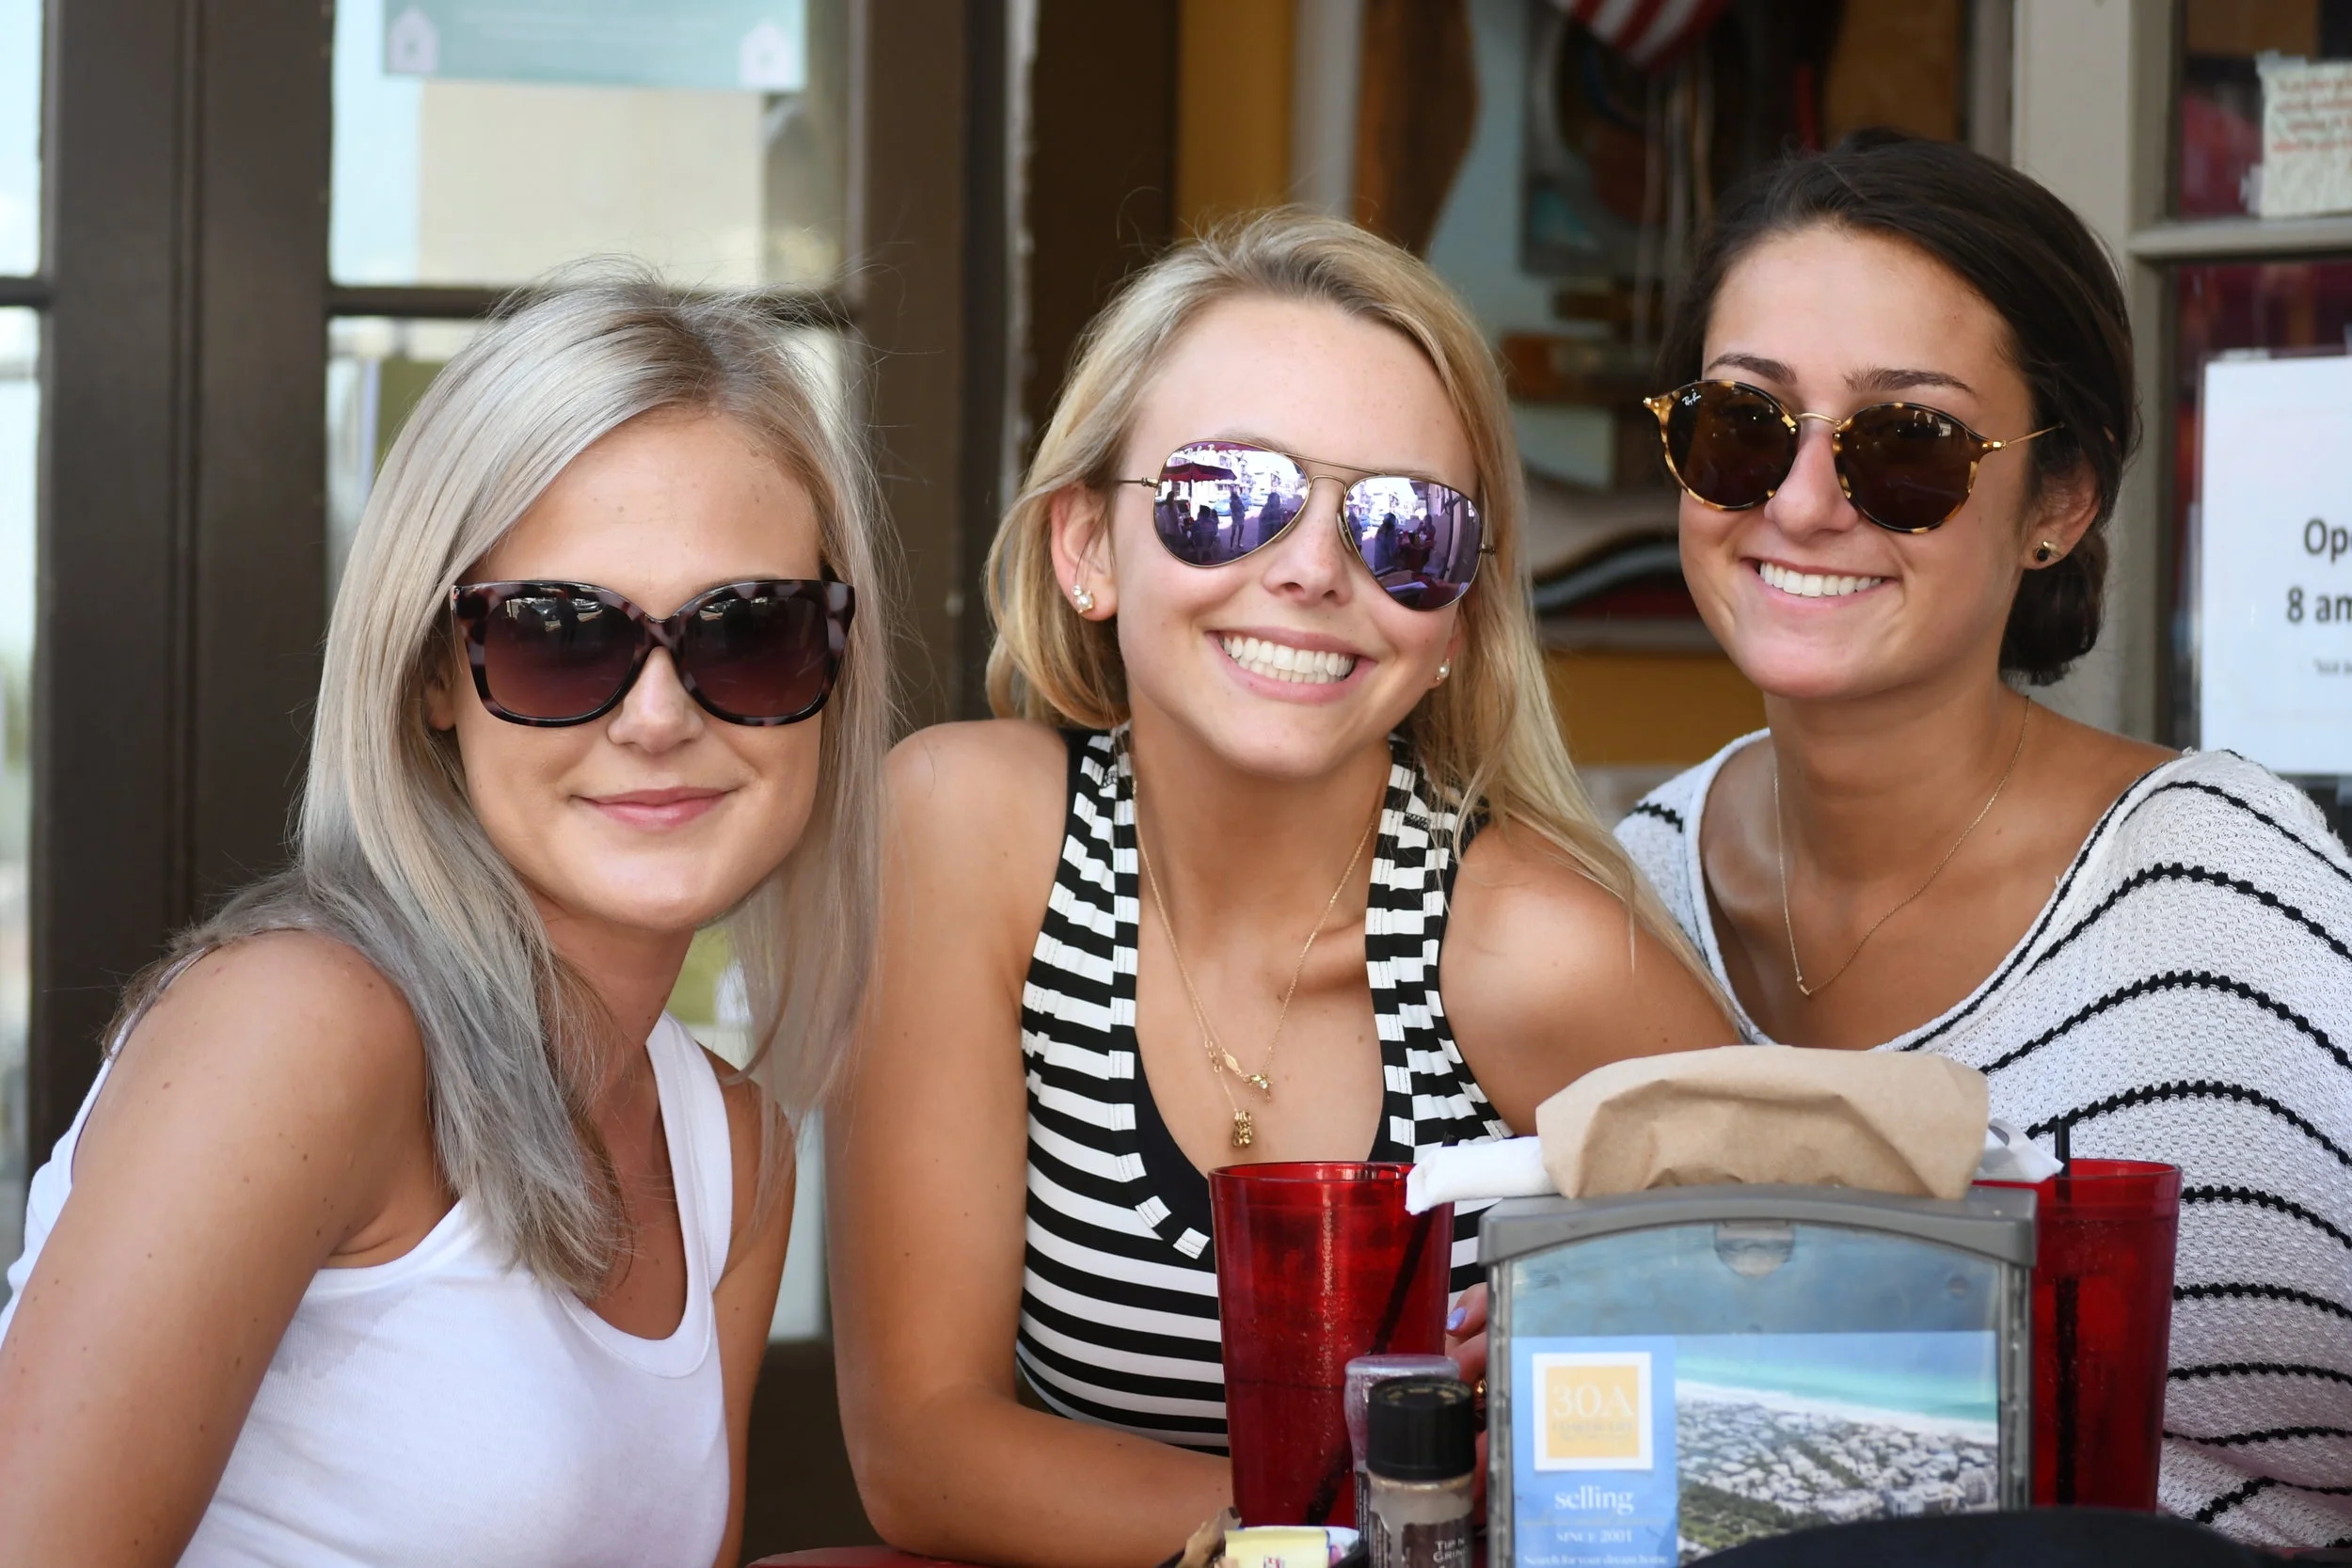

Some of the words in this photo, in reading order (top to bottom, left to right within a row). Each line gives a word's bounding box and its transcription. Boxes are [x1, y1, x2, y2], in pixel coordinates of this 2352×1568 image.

[2304, 518, 2352, 563] Op
[2287, 586, 2305, 625] 8
[1551, 1382, 1635, 1418] 30A
[1554, 1485, 1635, 1515] selling
[1556, 1529, 1595, 1544] SINCE
[1600, 1528, 1632, 1543] 2001
